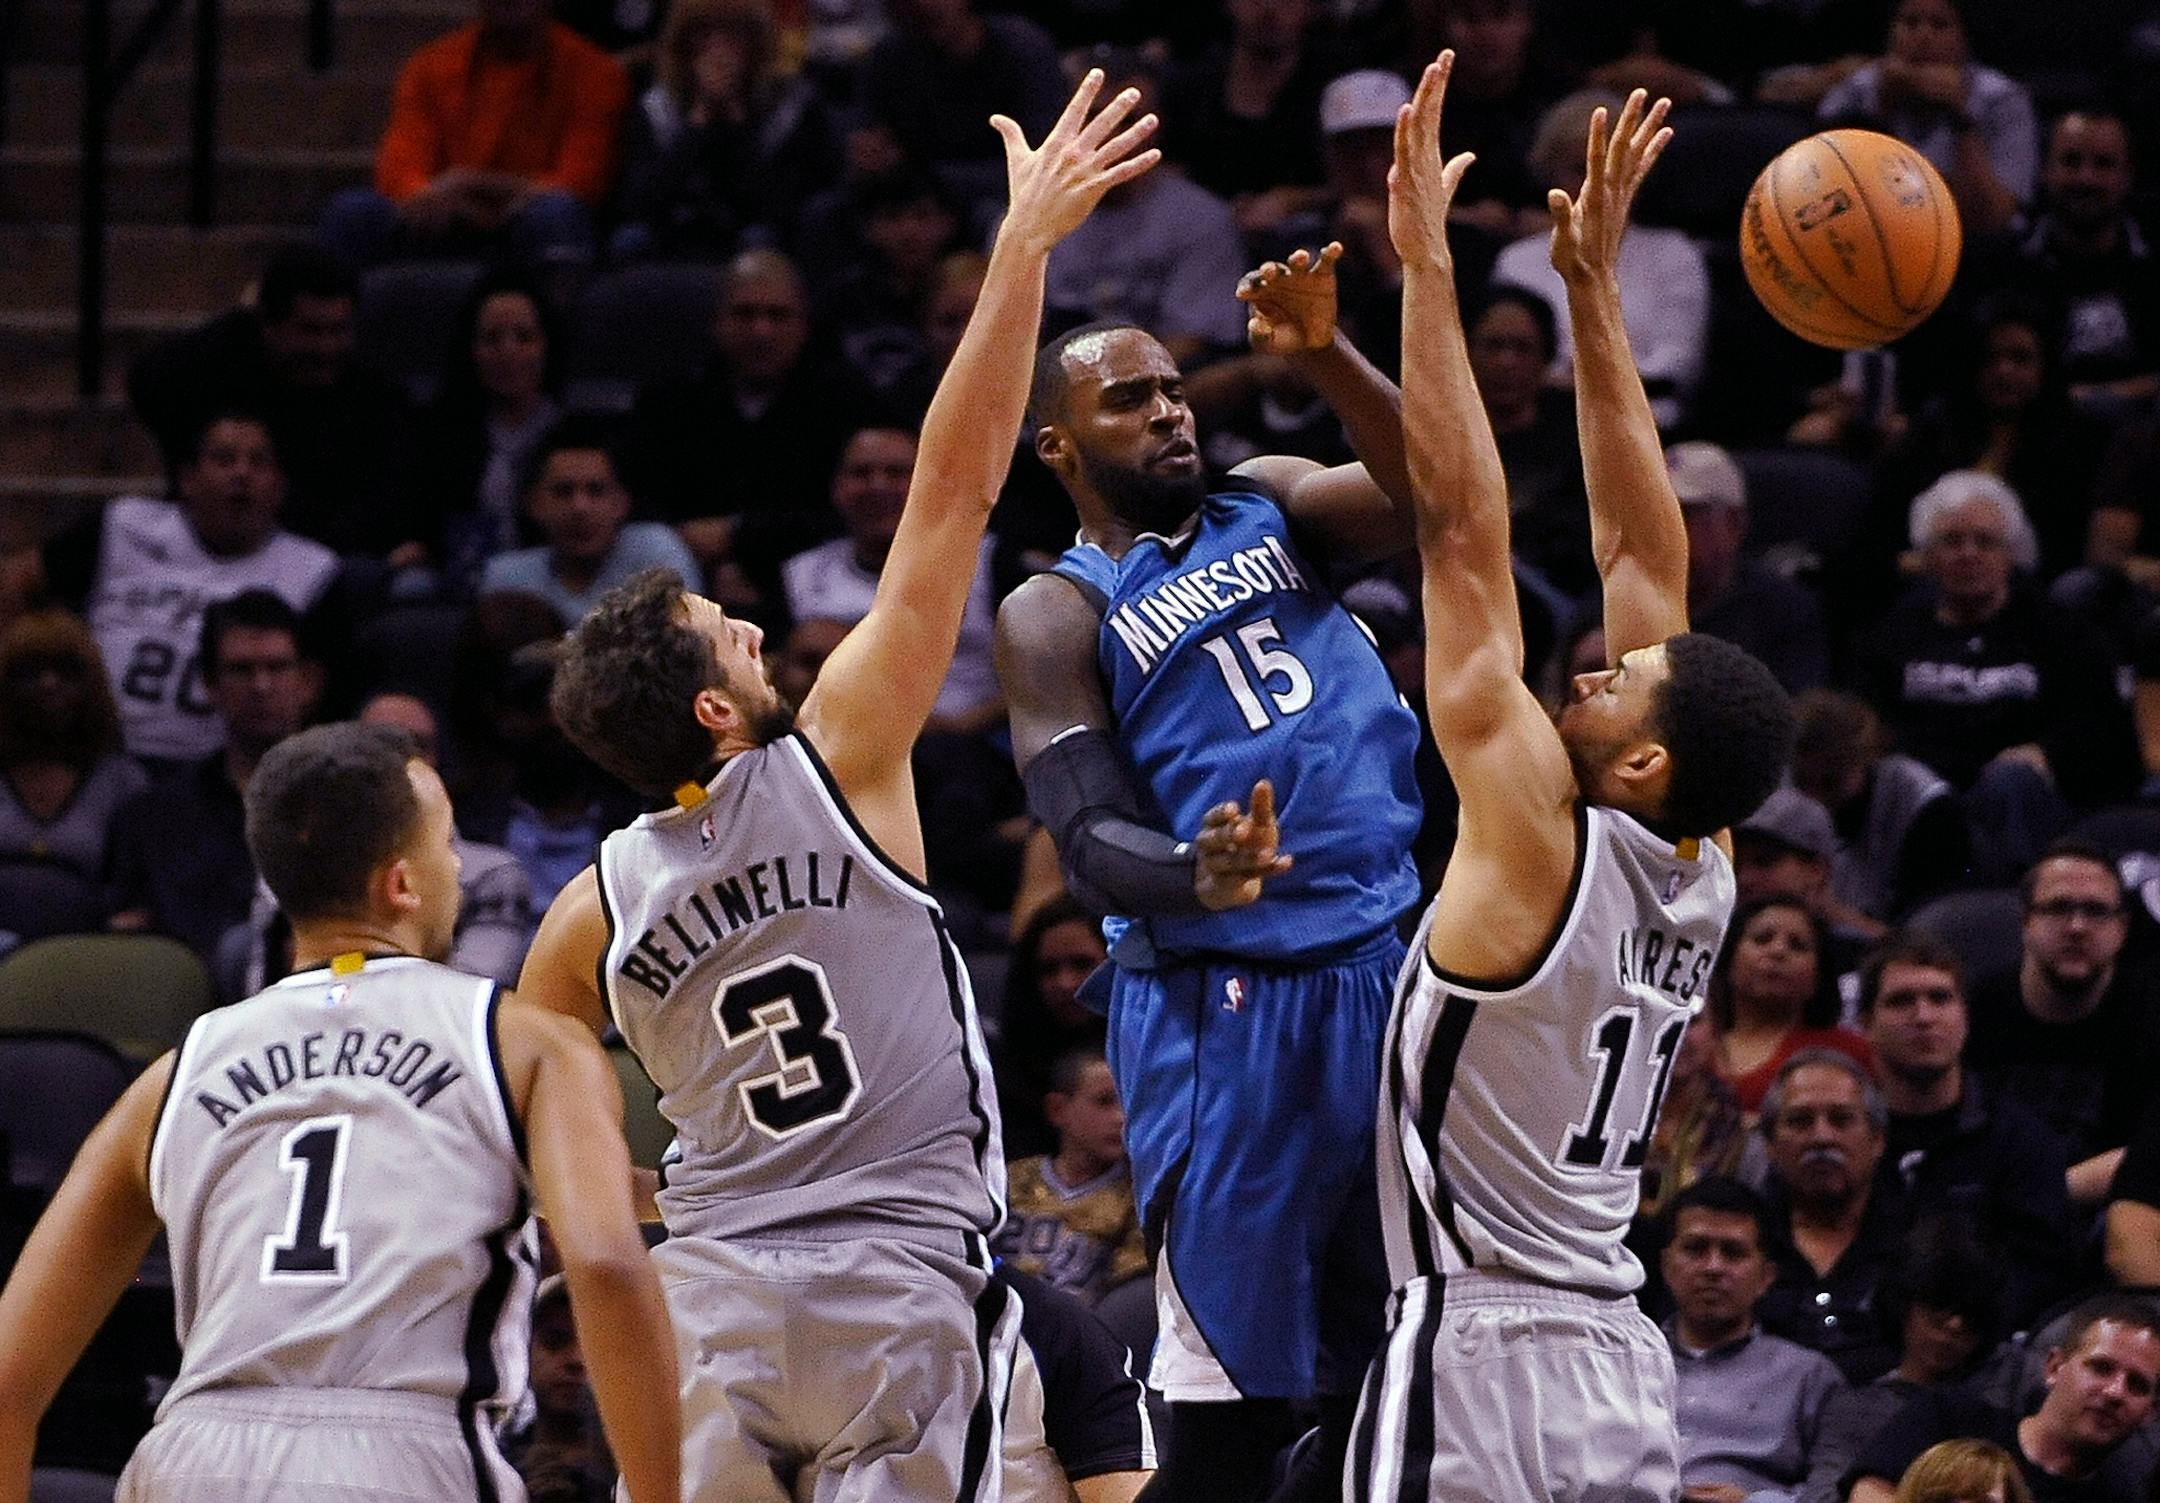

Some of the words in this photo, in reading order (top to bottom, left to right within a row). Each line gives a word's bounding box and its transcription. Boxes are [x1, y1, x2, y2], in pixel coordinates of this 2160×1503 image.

[1108, 535, 1309, 675] MINNESOTA
[1202, 617, 1314, 731] 15
[619, 851, 853, 1000] BELINELLI
[198, 1031, 460, 1128] ANDERSON
[711, 953, 863, 1139] 3
[1554, 1006, 1691, 1170] 11
[260, 1114, 353, 1282] 1
